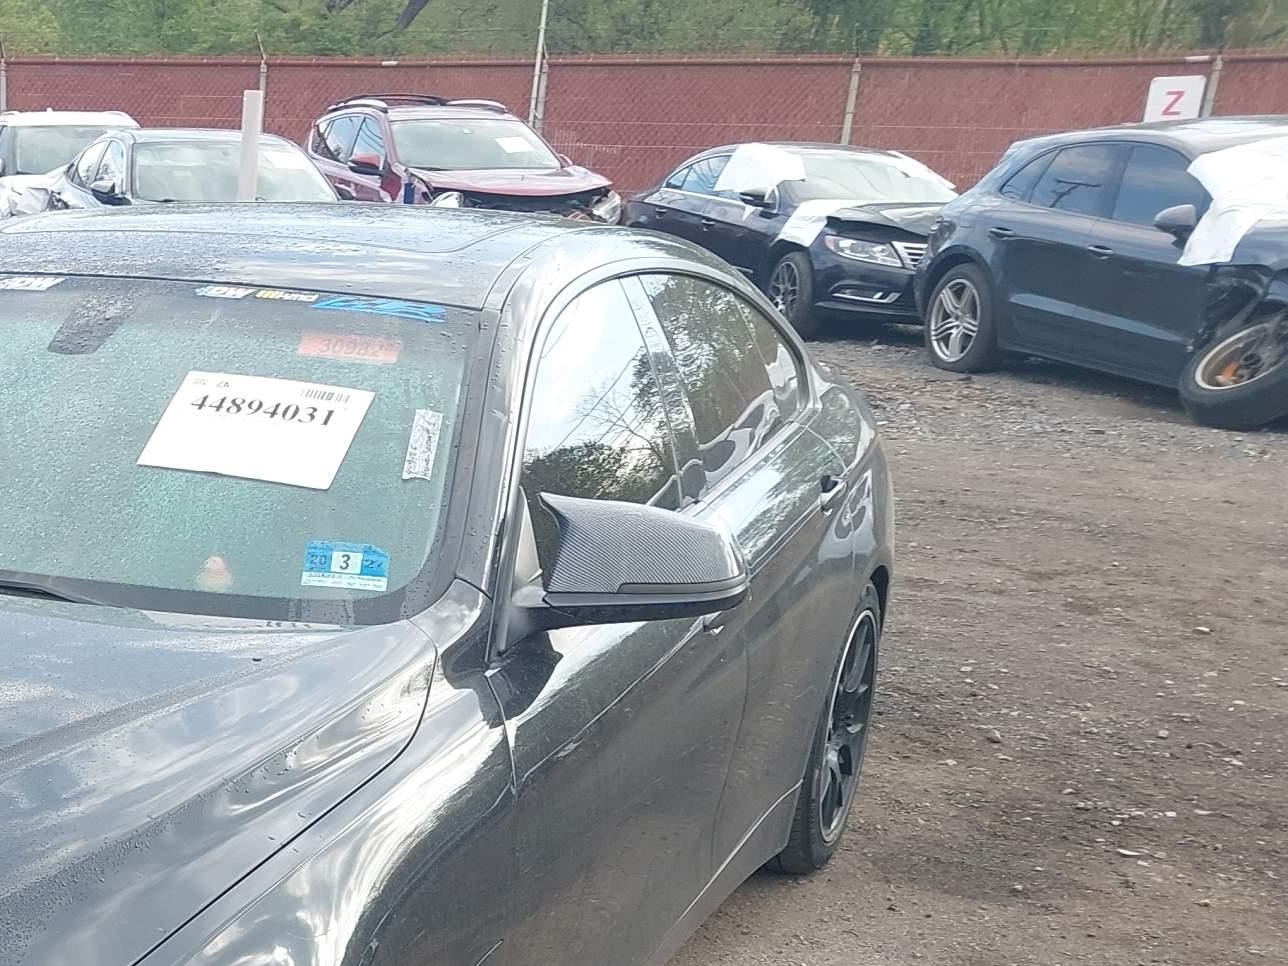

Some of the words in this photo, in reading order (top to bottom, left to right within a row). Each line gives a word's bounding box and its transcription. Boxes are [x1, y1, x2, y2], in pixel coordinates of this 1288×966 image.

[1161, 91, 1185, 115] Z
[191, 395, 334, 426] 44894031
[339, 554, 351, 570] 3
